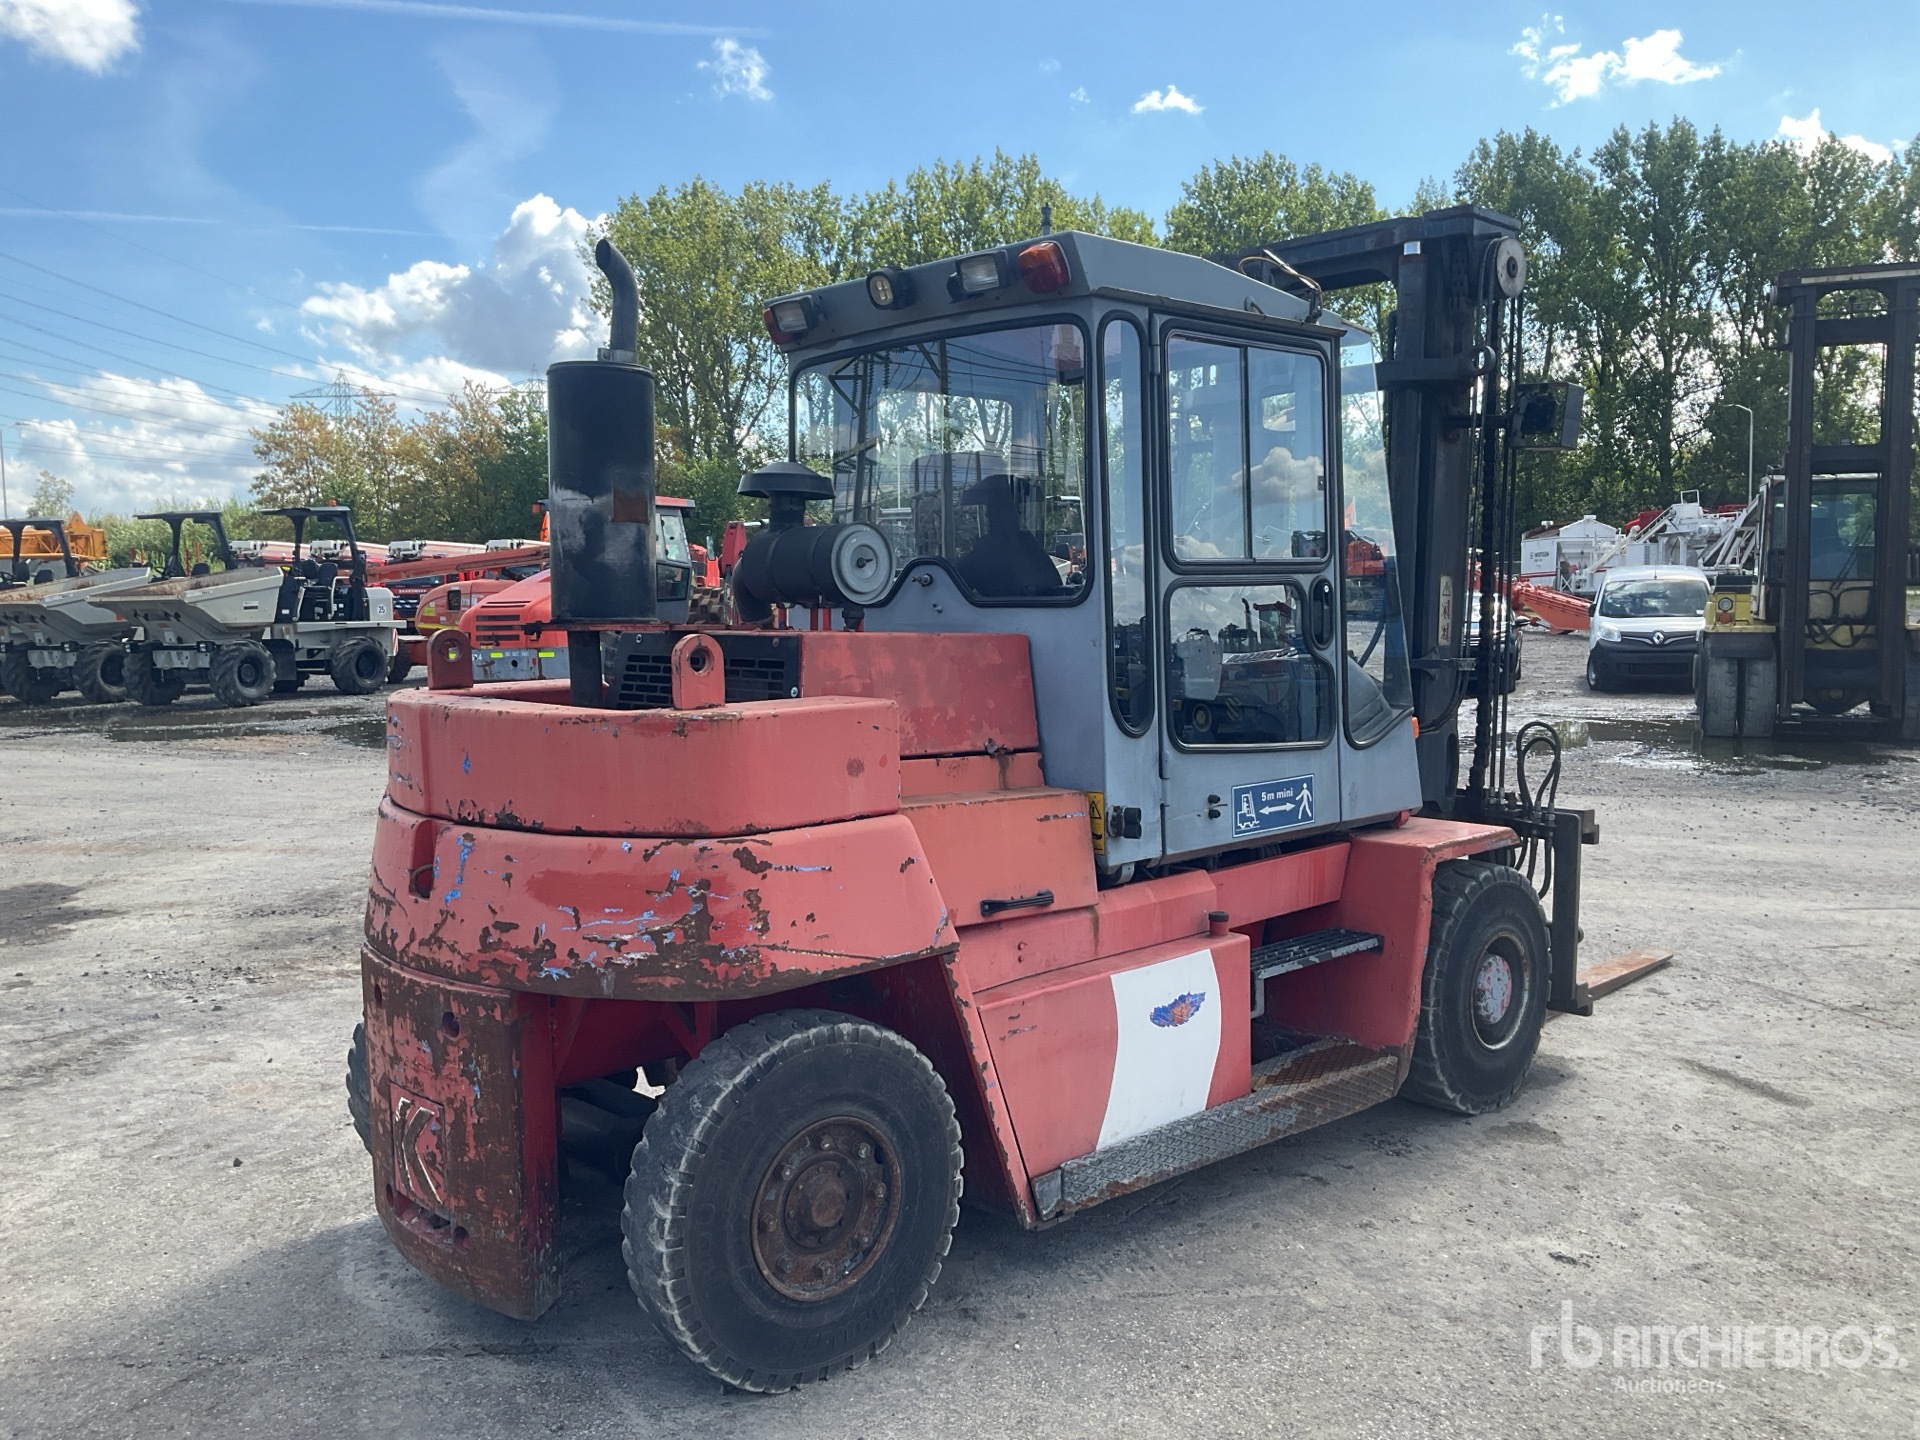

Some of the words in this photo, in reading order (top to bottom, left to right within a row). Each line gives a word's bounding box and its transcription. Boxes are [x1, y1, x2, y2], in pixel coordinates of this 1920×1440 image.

[378, 605, 385, 613] 25
[1261, 791, 1275, 802] 5m
[1276, 787, 1293, 799] mini
